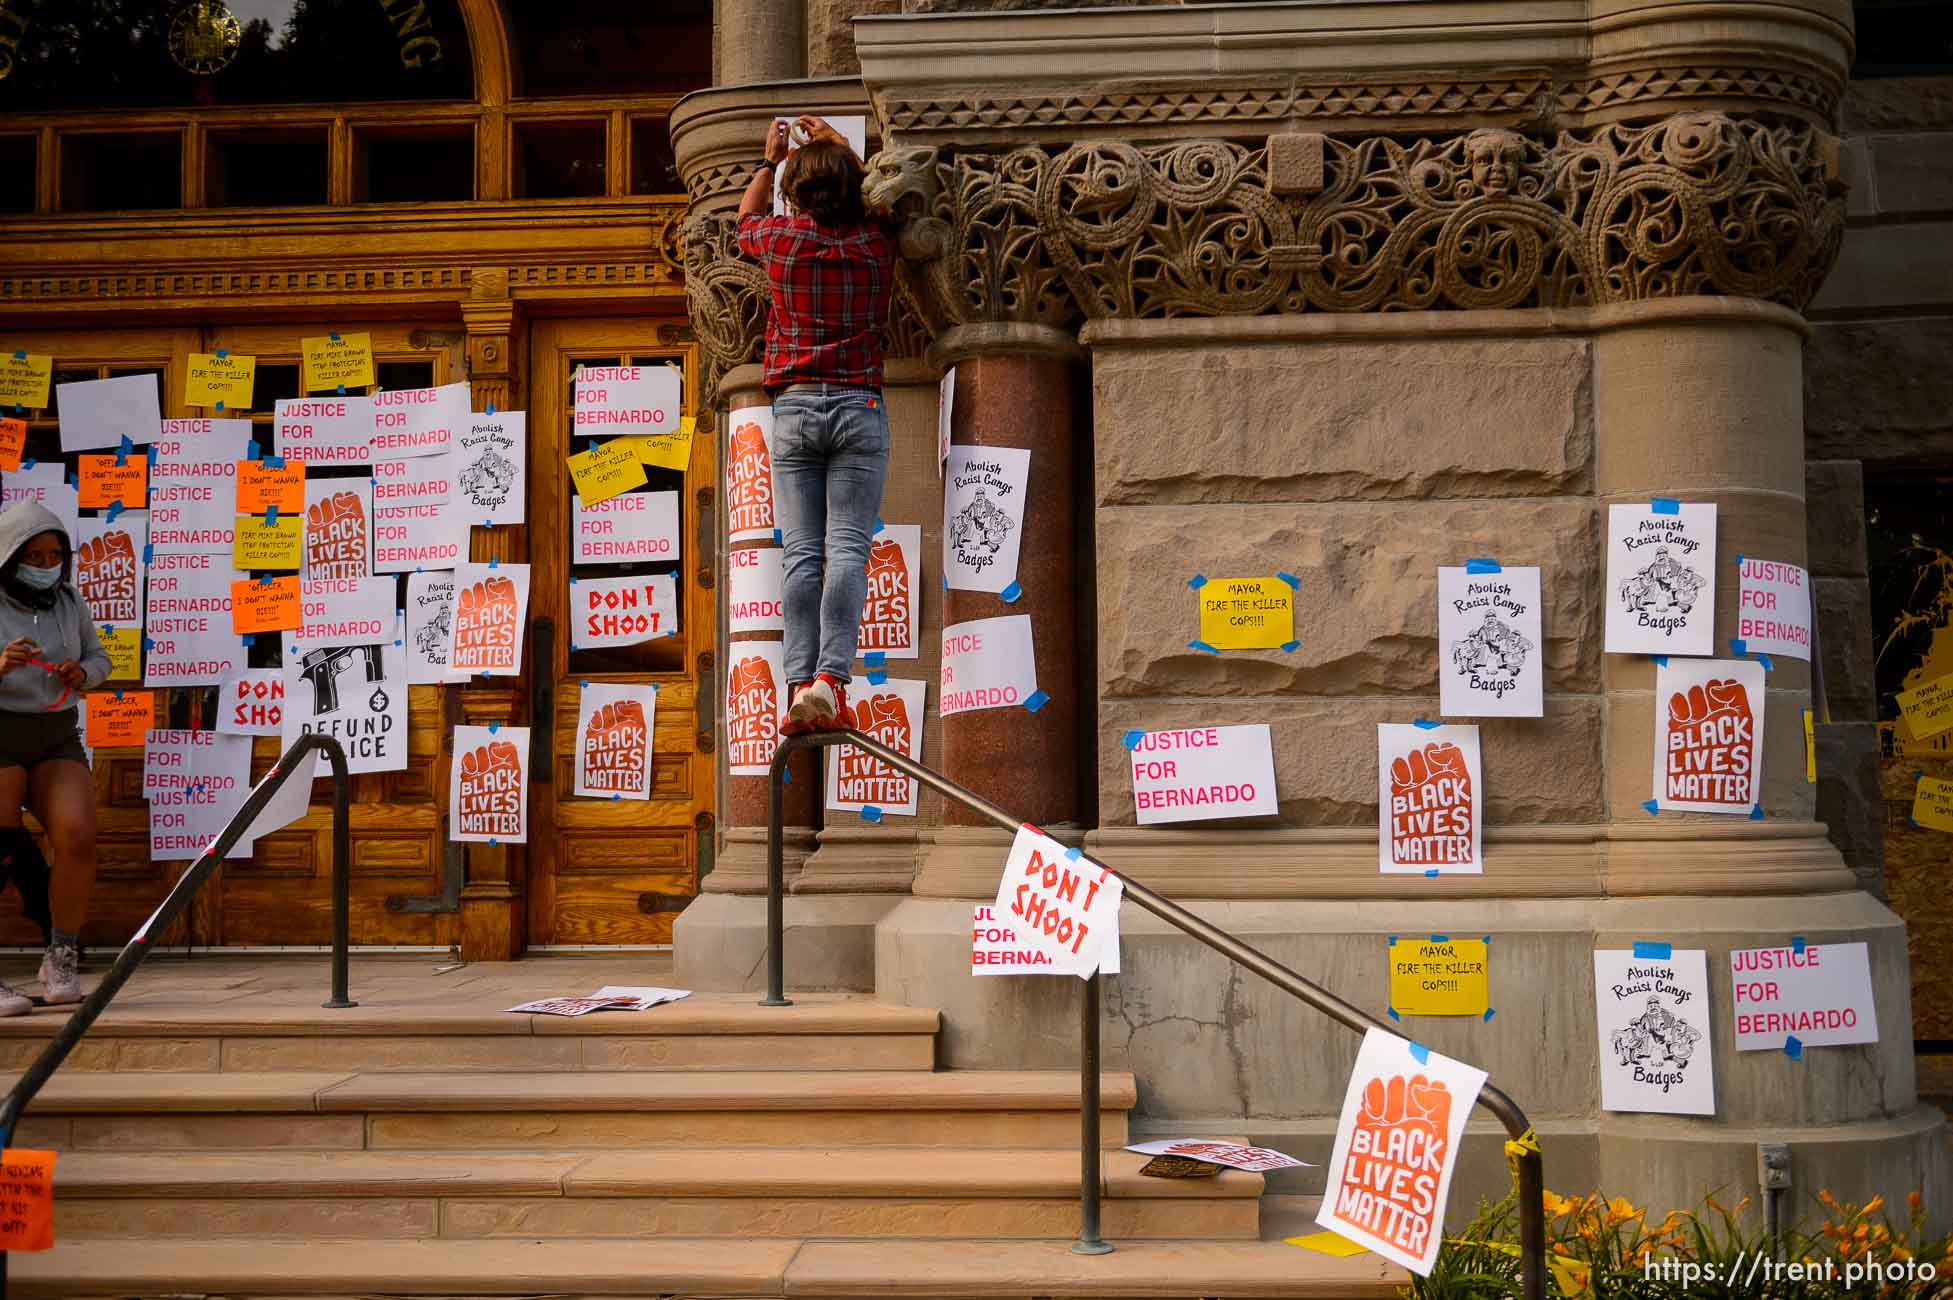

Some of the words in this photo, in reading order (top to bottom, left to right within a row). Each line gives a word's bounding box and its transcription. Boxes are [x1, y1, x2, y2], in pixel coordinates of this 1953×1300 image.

[576, 368, 641, 383] JUSTICE
[374, 389, 437, 406] JUSTICE
[576, 389, 608, 404] FOR
[282, 404, 346, 417] JUSTICE
[375, 412, 407, 428] FOR
[576, 409, 665, 424] BERNARDO
[161, 421, 211, 434] USTICE
[282, 425, 313, 439] FOR
[472, 424, 503, 434] Abolish
[461, 435, 488, 449] Racist
[282, 446, 370, 460] BERNARDO
[609, 450, 634, 465] KILLER
[152, 463, 235, 477] BERNARDO
[375, 463, 405, 476] FOR
[728, 452, 769, 488] LACK
[964, 460, 1002, 475] Abolish
[375, 480, 448, 498] BERNARD
[729, 478, 770, 506] IVES
[953, 475, 982, 490] Racist
[2, 488, 45, 500] STICE
[151, 488, 211, 500] JUSTICE
[472, 495, 506, 511] Badges
[152, 509, 179, 522] FOR
[729, 503, 772, 532] ATTER
[308, 518, 364, 547] BLACK
[376, 526, 407, 540] FOR
[581, 520, 613, 534] FOR
[1638, 520, 1684, 533] Abolish
[152, 530, 234, 544] BERNARDO
[1623, 534, 1661, 552] Racist
[1665, 532, 1700, 554] Gangs
[308, 538, 364, 563] LIVES
[376, 544, 458, 562] BERNARDO
[582, 539, 671, 556] BERNARDO
[79, 556, 135, 585] BLACK
[150, 556, 209, 569] JUSTICE
[309, 559, 366, 580] MATTER
[957, 549, 993, 573] Badges
[1742, 560, 1801, 586] JUSTICE
[150, 577, 177, 591] FOR
[303, 580, 358, 595] USTICE
[428, 583, 455, 592] Abolis
[866, 572, 908, 600] ACK
[1228, 583, 1264, 595] MAYOR,
[1467, 582, 1511, 596] Abolish
[90, 600, 135, 619] ATTER
[149, 599, 232, 613] BERNARDO
[301, 603, 326, 617] OR
[862, 596, 907, 622] VES
[1206, 600, 1227, 611] FIRE
[1232, 600, 1249, 610] THE
[1252, 599, 1288, 610] KILLER
[1453, 596, 1490, 615] Racist
[1493, 595, 1526, 617] Gangs
[1741, 590, 1776, 611] FOR
[148, 619, 207, 633] JUSTICE
[458, 603, 515, 631] BLACK
[588, 612, 661, 637] SHOOT
[1230, 615, 1264, 626] COPS!!!
[1638, 612, 1687, 636] Badges
[296, 620, 382, 639] BERNARDO
[456, 624, 513, 647] LIVES
[857, 622, 908, 647] ATTER
[943, 634, 983, 657] STICE
[455, 646, 513, 666] MATTER
[1469, 675, 1516, 699] Badges
[942, 686, 1018, 712] ERNARDO
[586, 727, 645, 751] BLACK
[1670, 715, 1752, 751] BLACK
[147, 752, 181, 766] FOR
[586, 748, 644, 770] LIVES
[1669, 745, 1750, 774] LIVES
[584, 769, 643, 791] MATTER
[1135, 761, 1176, 781] FOR
[146, 774, 234, 789] BERNARDO
[461, 768, 520, 796] BLACK
[840, 778, 907, 801] MATTER
[1668, 773, 1749, 801] MATTER
[152, 790, 216, 806] JUSTICE
[461, 791, 519, 814] LIVES
[1137, 783, 1256, 810] BERNARDO
[1393, 777, 1471, 815] BLACK
[153, 814, 185, 828] FOR
[461, 813, 520, 834] MATTER
[1393, 806, 1471, 838] LIVES
[1393, 835, 1472, 863] MATTER
[1010, 884, 1089, 954] SHOOT
[973, 929, 1016, 942] FOR
[1420, 946, 1457, 958] MAYOR,
[1734, 947, 1821, 971] JUSTICE
[1397, 963, 1420, 975] FIRE
[1423, 963, 1441, 974] THE
[1446, 962, 1483, 975] KILLER
[1626, 966, 1674, 981] Abolish
[1422, 980, 1458, 992] COPS!!!
[1611, 981, 1651, 1001] Racist
[1655, 980, 1692, 1004] Gangs
[1735, 982, 1778, 1003] FOR
[1737, 1008, 1857, 1034] BERNARDO
[1633, 1066, 1684, 1093] Badges
[1352, 1127, 1446, 1173] BLACK
[1346, 1156, 1435, 1216] LIVES
[1337, 1184, 1430, 1254] MATTER
